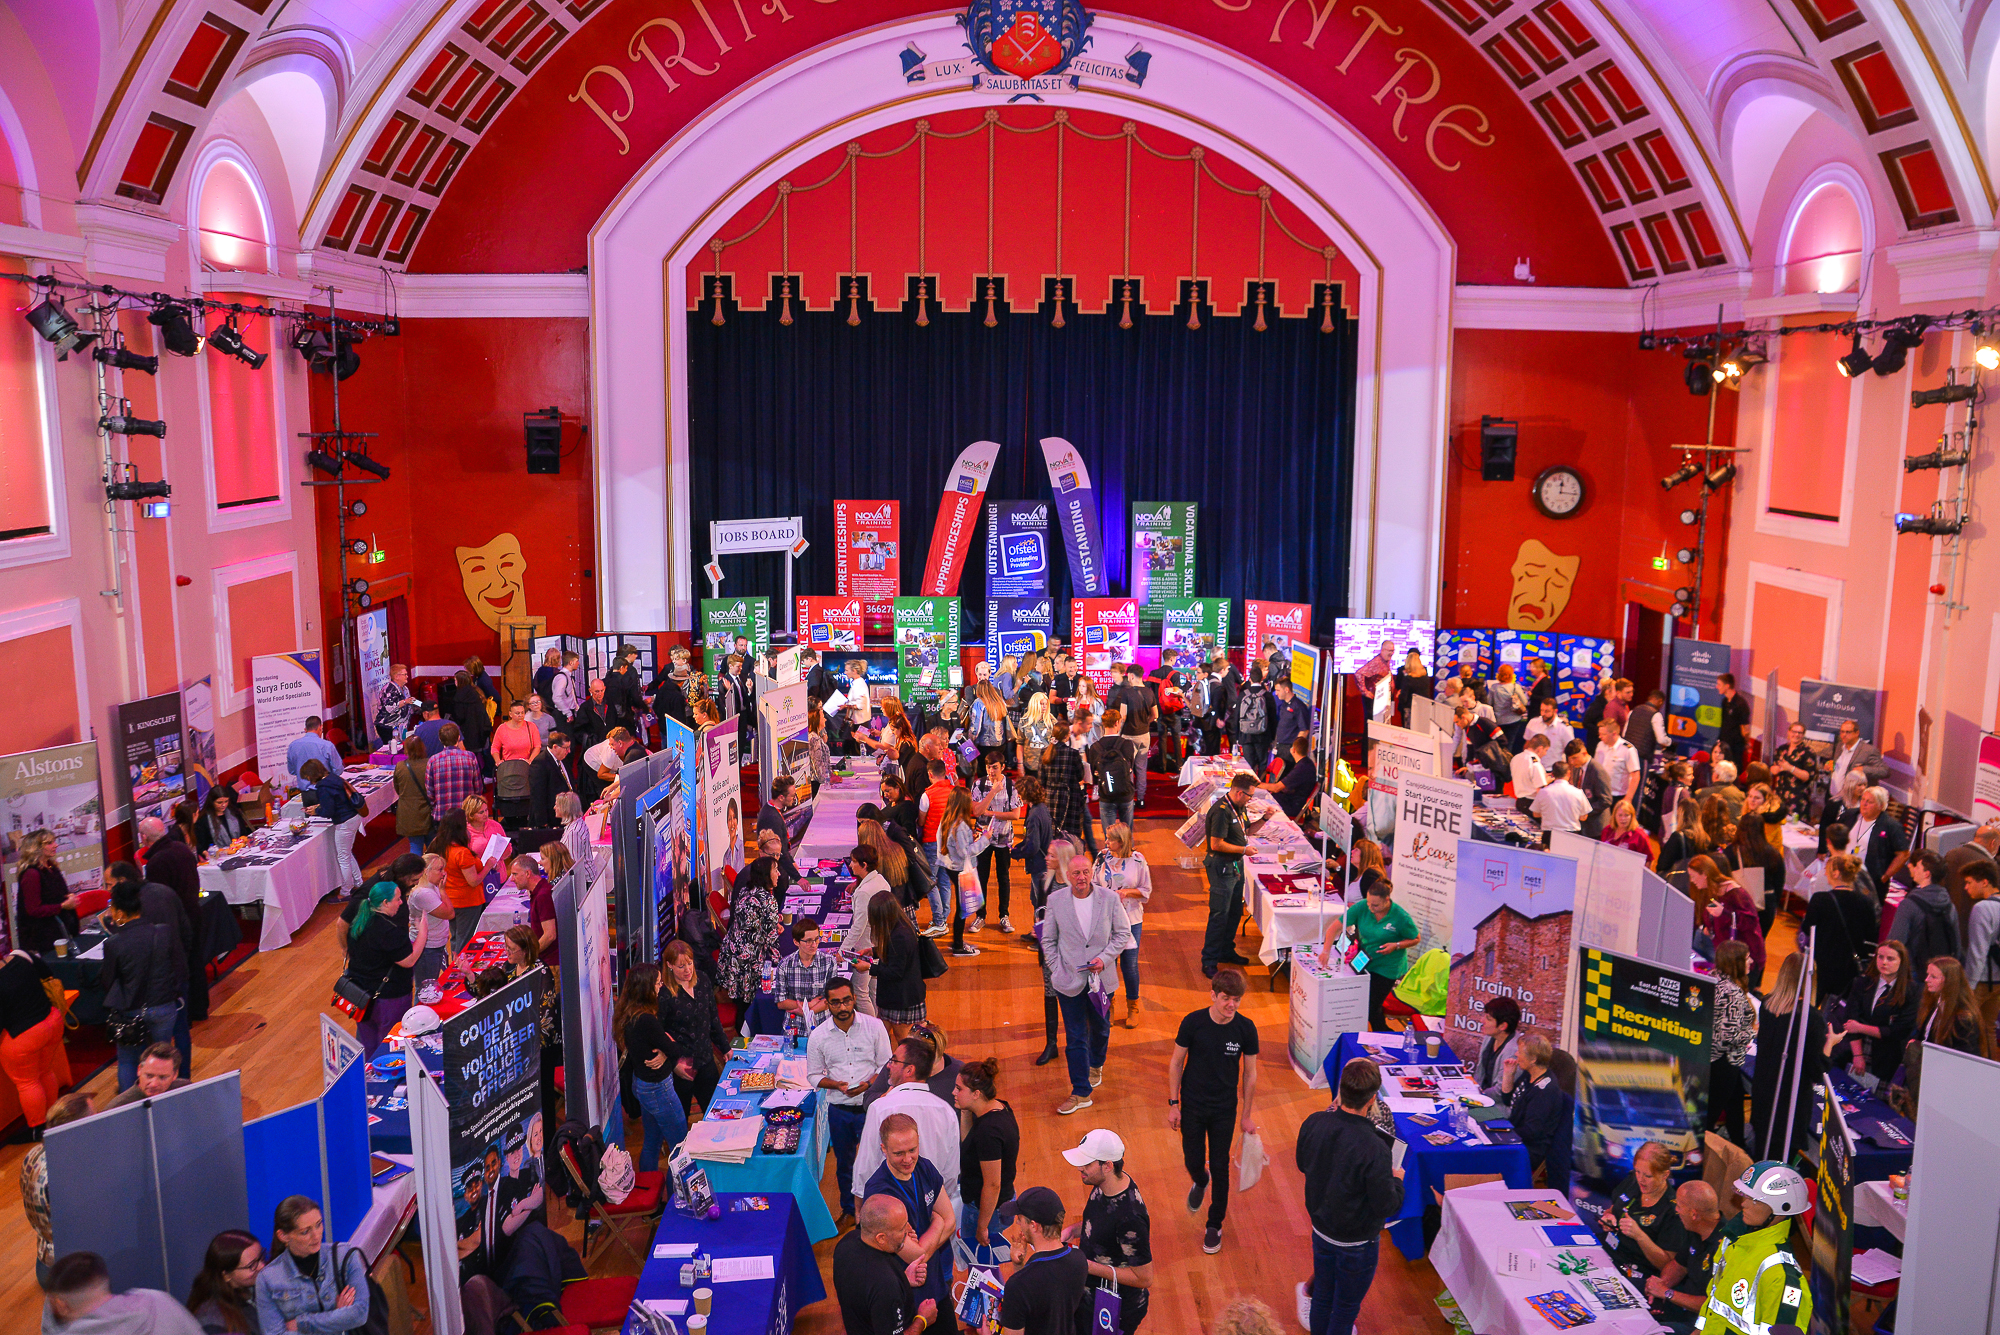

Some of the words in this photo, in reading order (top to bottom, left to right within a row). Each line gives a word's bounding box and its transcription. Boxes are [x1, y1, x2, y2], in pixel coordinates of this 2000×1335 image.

[1074, 60, 1124, 79] FELICITAS
[962, 459, 981, 470] NOVA
[962, 466, 986, 475] TRAINING
[1050, 458, 1068, 467] NOVA
[855, 510, 883, 519] NOVA
[1012, 510, 1039, 520] NOVA
[1136, 511, 1164, 520] NOVA
[719, 531, 748, 545] JOBS
[751, 529, 795, 541] BOARD
[989, 503, 997, 574] OUTSTANDING!
[1185, 505, 1195, 566] VOCATIONAL
[935, 496, 968, 595] APPRENTICESHIPS
[1009, 543, 1037, 555] Ofsted
[1069, 500, 1096, 592] OUTSTANDING
[1009, 555, 1038, 563] Outstanding
[709, 608, 738, 618] NOVA
[800, 599, 808, 635] SKILLS
[823, 606, 852, 616] NOVA
[896, 607, 925, 616] NOVA
[1012, 607, 1041, 617] NOVA
[1074, 601, 1084, 637] SKILLS
[1098, 608, 1127, 618] NOVA
[1166, 607, 1195, 616] NOVA
[1266, 612, 1294, 623] NOVA
[949, 600, 958, 663] VOCATIONAL
[988, 600, 998, 674] OUTSTANDING!
[1004, 643, 1032, 652] Ofsted
[255, 674, 278, 682] Introducing
[256, 683, 278, 694] Surya
[280, 680, 302, 691] Foods
[285, 691, 311, 700] Specialists
[1817, 700, 1856, 712] lifehouse
[137, 714, 176, 730] KINGSCLIFF
[14, 756, 83, 780] Alstons
[1377, 749, 1421, 770] RECRUITING
[712, 780, 721, 794] Skills
[721, 774, 730, 787] and
[1405, 779, 1464, 799] Carejobsclacton.com
[712, 791, 727, 806] careers
[726, 784, 739, 797] advice
[1405, 789, 1421, 800] Start
[1423, 794, 1439, 803] your
[1439, 798, 1463, 810] career
[713, 806, 722, 818] here
[1403, 800, 1461, 835] HERE
[1326, 815, 1344, 846] HERE
[1486, 867, 1505, 878] nett
[1524, 875, 1542, 885] nett
[1474, 976, 1513, 998] Train
[1517, 985, 1534, 1002] to
[1638, 980, 1651, 989] East
[1657, 986, 1680, 997] England
[1660, 978, 1679, 990] NHS
[1630, 984, 1660, 997] Ambulance
[1660, 992, 1679, 1003] Service
[460, 1009, 504, 1047] COULD
[505, 990, 533, 1018] YOU
[1521, 1008, 1536, 1025] in
[1612, 1003, 1703, 1045] Recruiting
[483, 1026, 500, 1050] BE
[503, 1020, 512, 1038] A
[1611, 1022, 1651, 1042] now
[461, 1022, 536, 1081] VOLUNTEER
[478, 1045, 522, 1088] POLICE
[472, 1057, 531, 1108] OFFICER?
[461, 1129, 471, 1138] The
[470, 1116, 484, 1133] Special
[510, 1091, 520, 1102] now
[519, 1080, 539, 1095] recruiting
